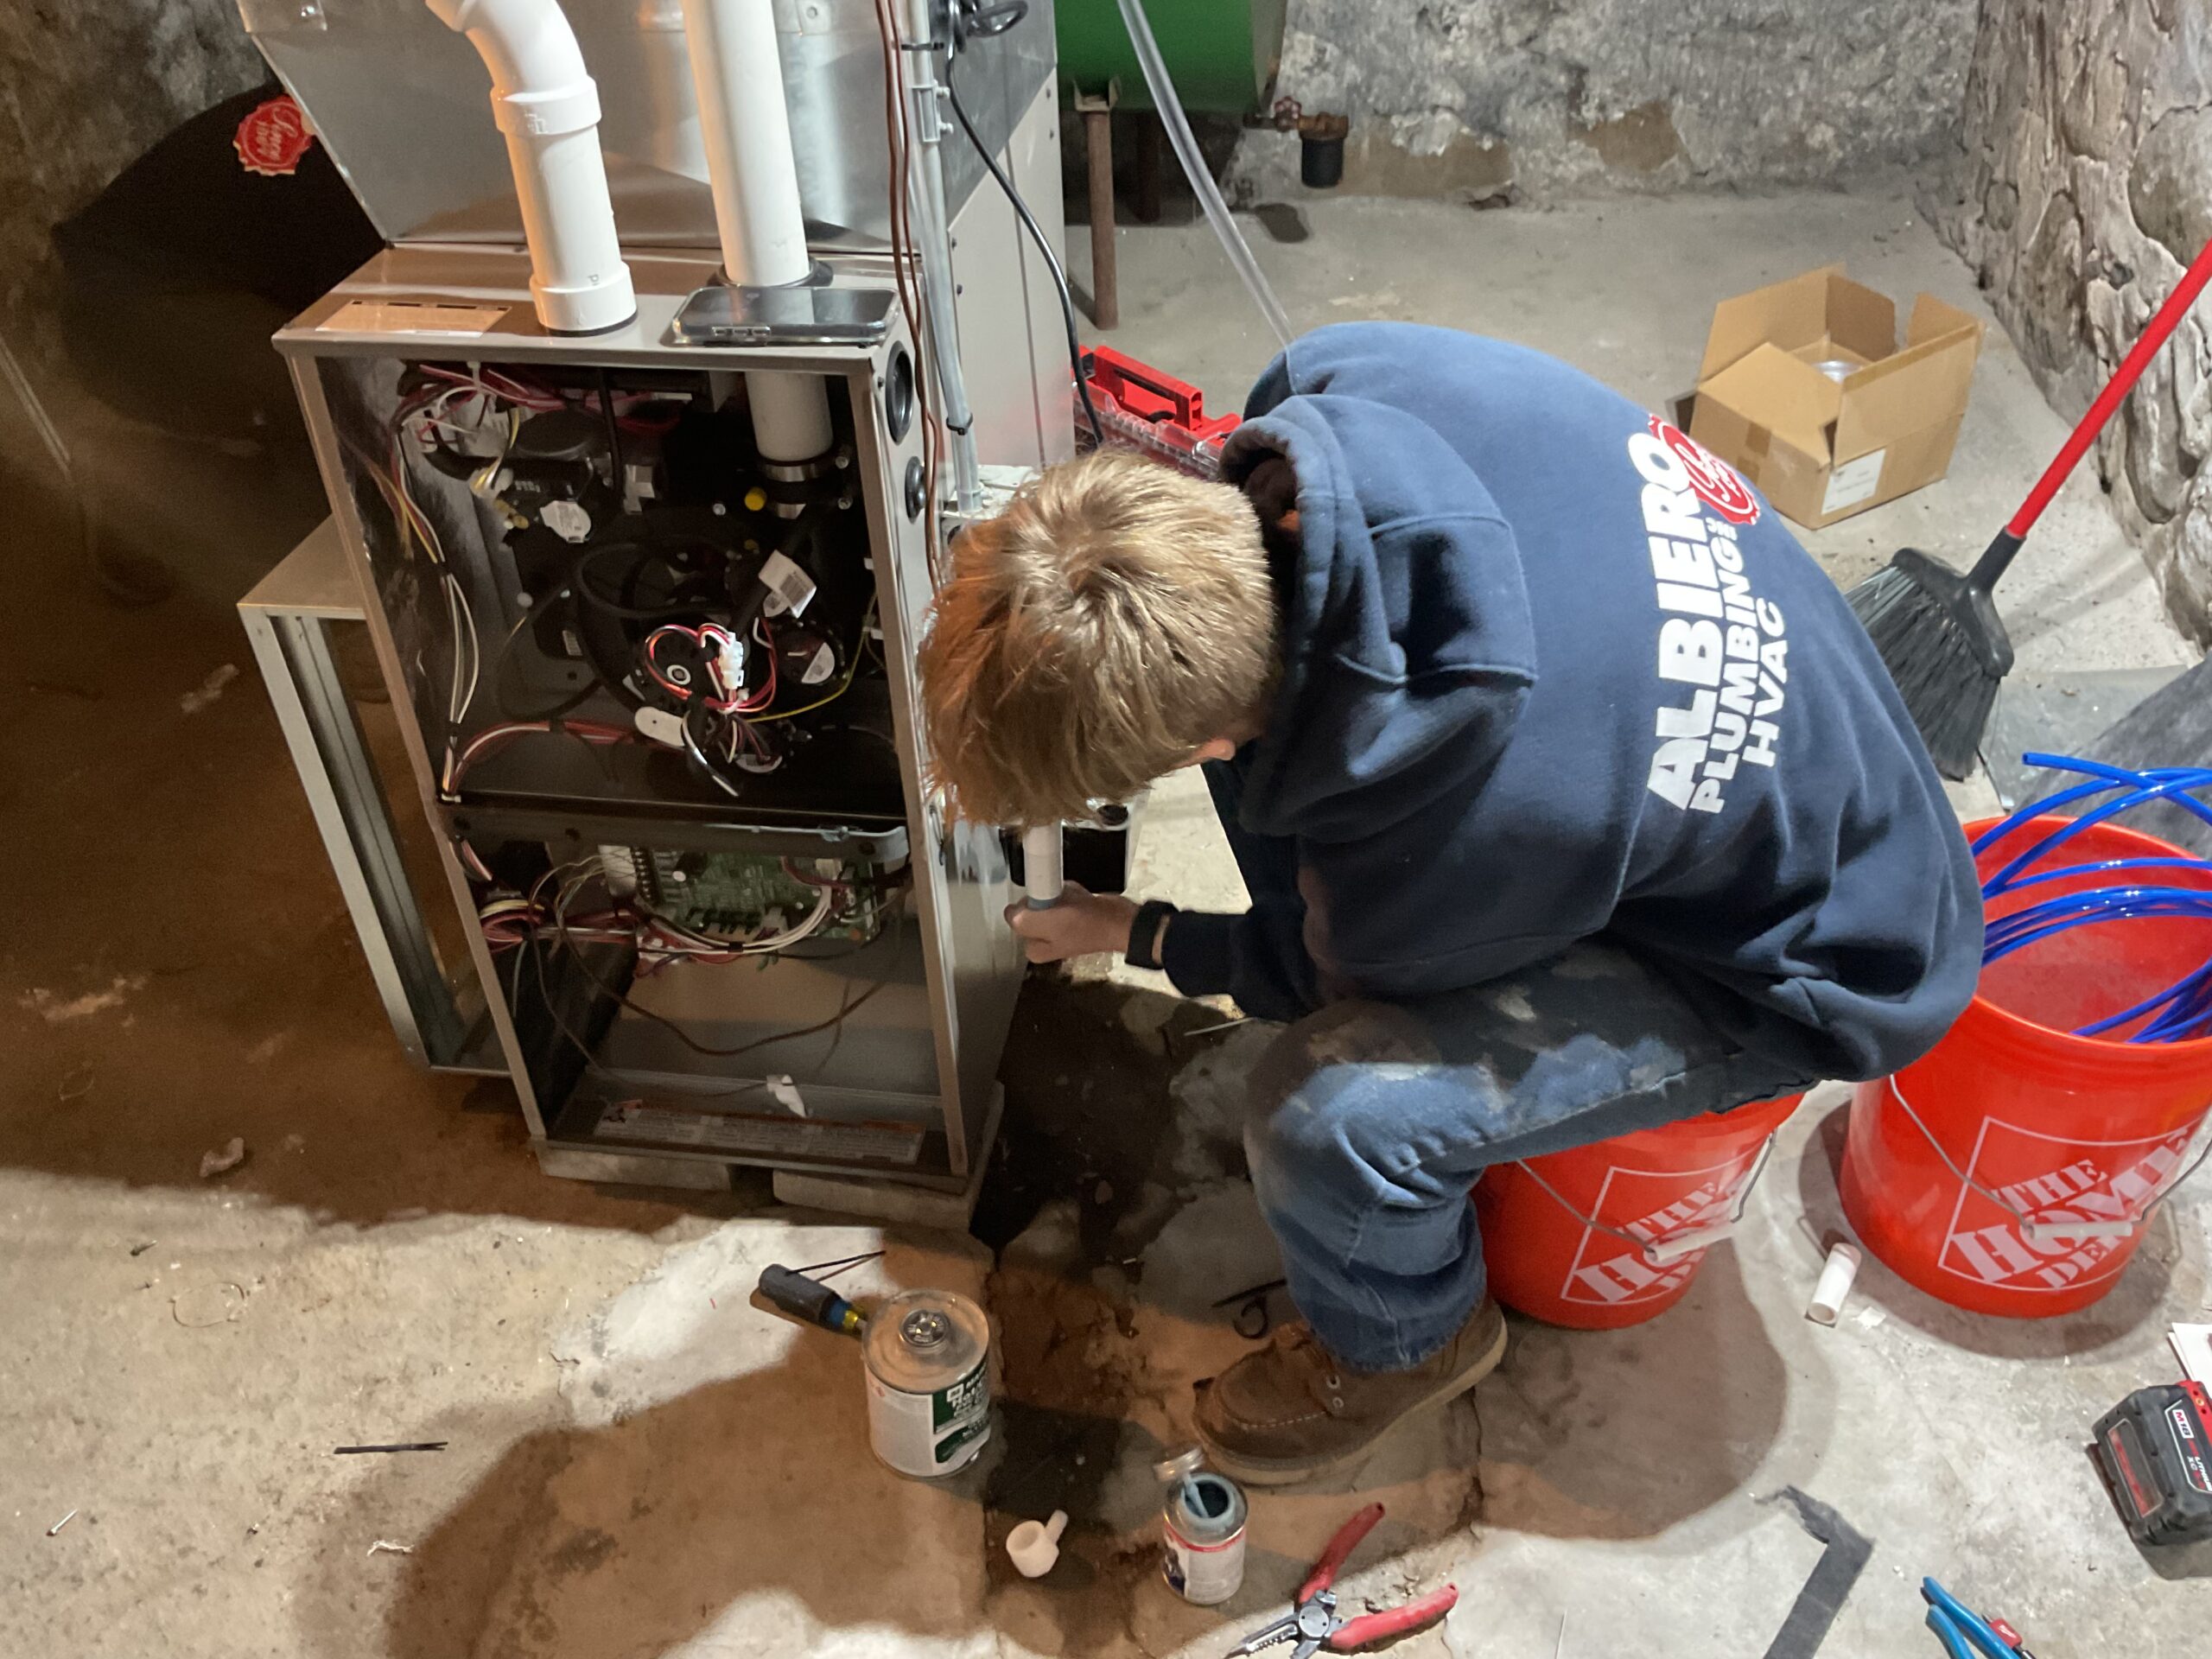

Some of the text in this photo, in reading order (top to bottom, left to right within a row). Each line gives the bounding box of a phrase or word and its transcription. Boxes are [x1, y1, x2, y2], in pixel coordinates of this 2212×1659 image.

[1628, 432, 1723, 810] ALBIERO
[1689, 536, 1759, 813] PLUMBING
[1742, 597, 1788, 767] HVAC
[1613, 1182, 1715, 1245] THE
[1991, 1158, 2108, 1215] THE
[2174, 1410, 2193, 1437] M18
